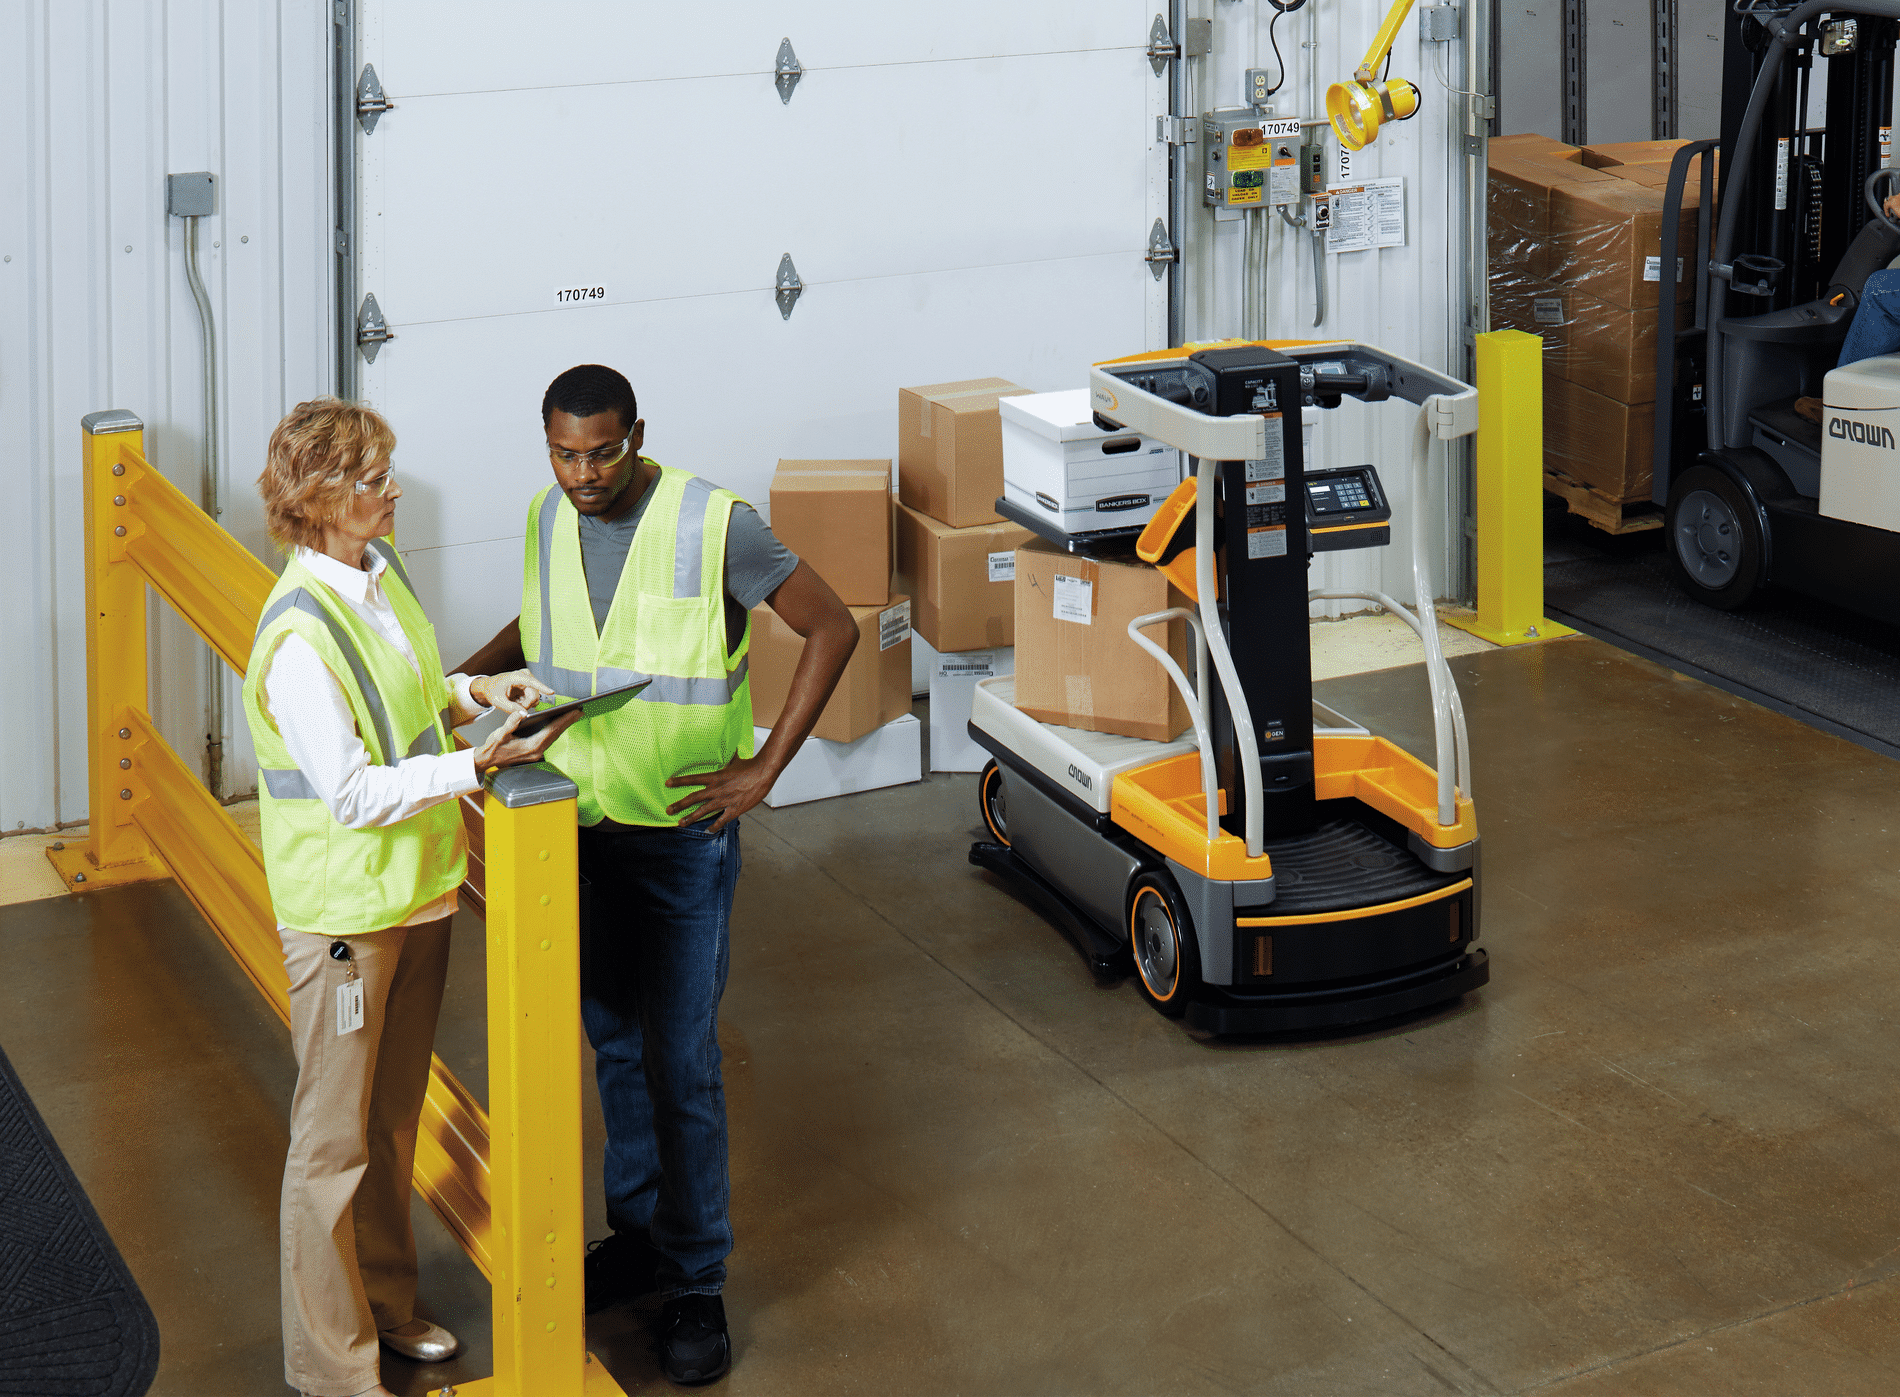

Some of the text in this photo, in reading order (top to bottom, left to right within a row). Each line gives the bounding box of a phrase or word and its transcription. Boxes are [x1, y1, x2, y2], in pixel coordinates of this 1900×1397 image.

[1261, 122, 1299, 135] 170749
[1341, 143, 1350, 178] 1707
[557, 287, 604, 302] 170749
[1829, 417, 1895, 450] CROWN
[1099, 499, 1132, 509] BANKERS
[1068, 763, 1092, 791] CROWN
